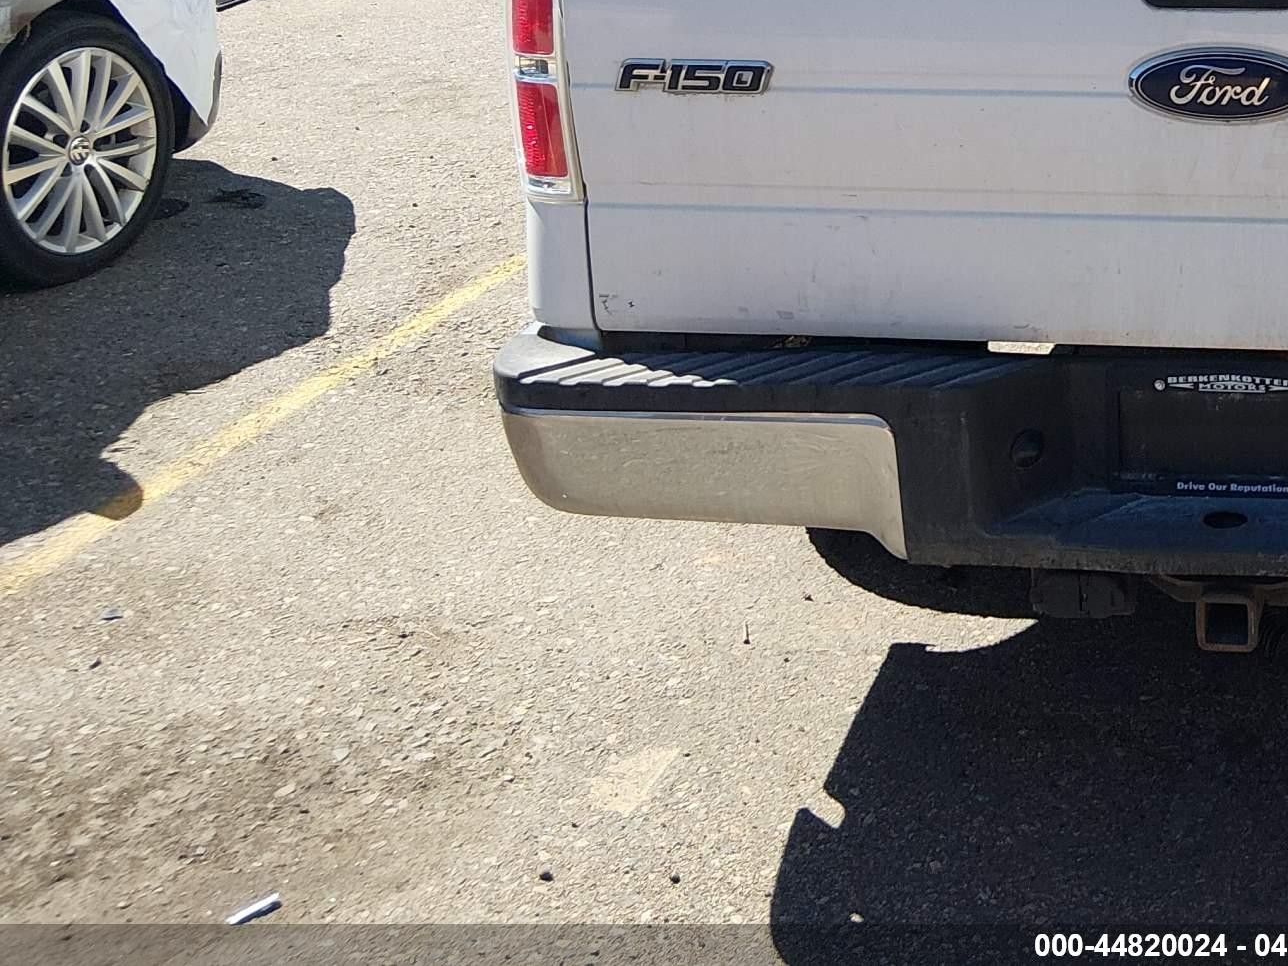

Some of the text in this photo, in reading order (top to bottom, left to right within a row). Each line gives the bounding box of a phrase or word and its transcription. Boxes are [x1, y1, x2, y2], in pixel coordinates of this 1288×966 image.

[614, 58, 774, 95] F-150
[1170, 64, 1271, 106] Ford
[1199, 383, 1266, 392] MOTORS
[1177, 481, 1288, 493] Drive Our Reputation
